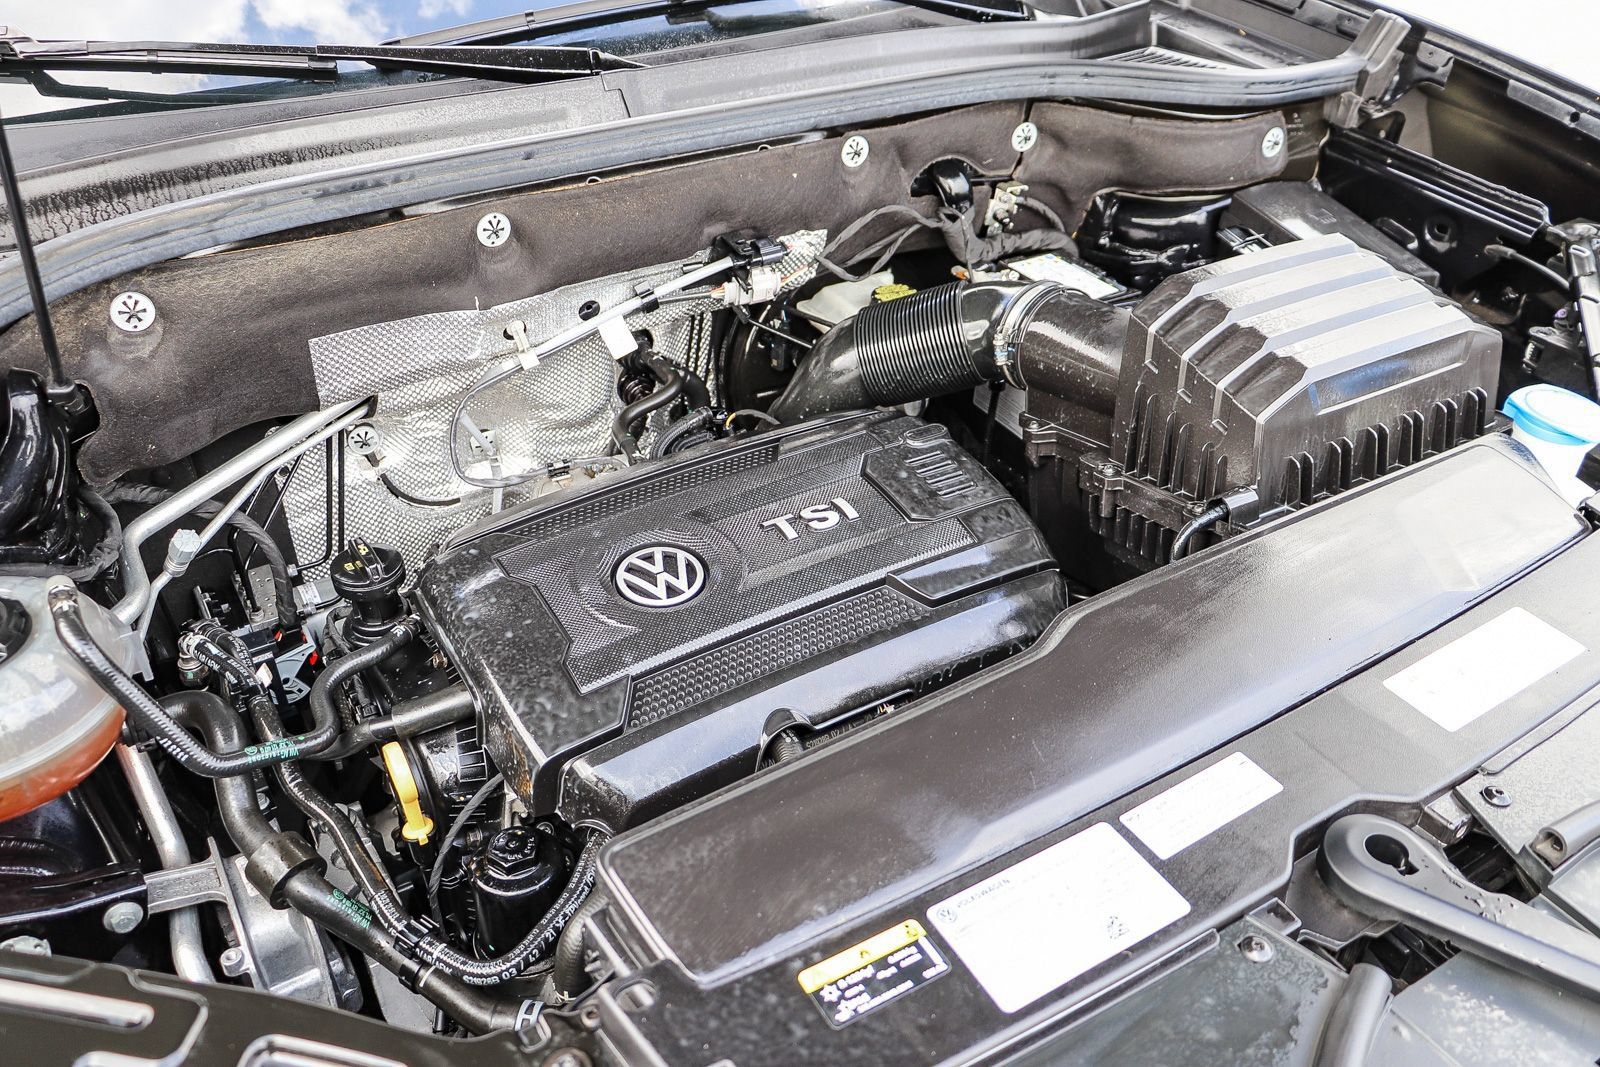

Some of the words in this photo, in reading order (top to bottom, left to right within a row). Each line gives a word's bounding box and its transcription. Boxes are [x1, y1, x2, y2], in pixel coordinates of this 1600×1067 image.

[760, 497, 860, 542] TSI
[615, 546, 706, 608] VW
[502, 967, 518, 980] 03
